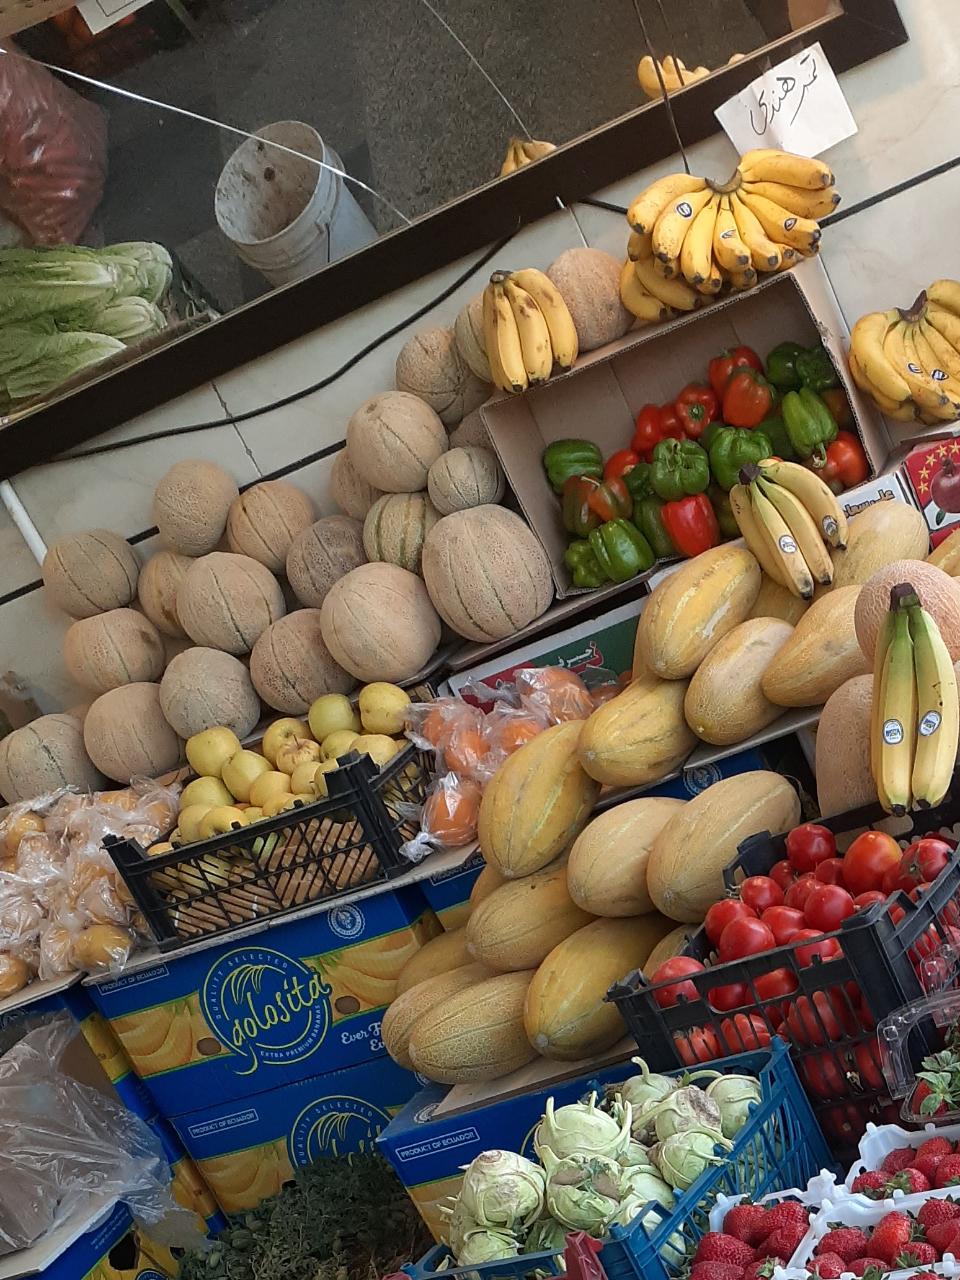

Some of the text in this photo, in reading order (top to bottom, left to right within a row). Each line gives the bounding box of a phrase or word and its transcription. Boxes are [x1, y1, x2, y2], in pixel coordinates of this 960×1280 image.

[210, 954, 288, 1019] QUALITY SELECTED
[341, 1030, 370, 1045] Ever
[315, 1102, 374, 1117] SELECTED
[400, 1142, 432, 1158] PRODUCT
[442, 1131, 475, 1146] ECUADOR
